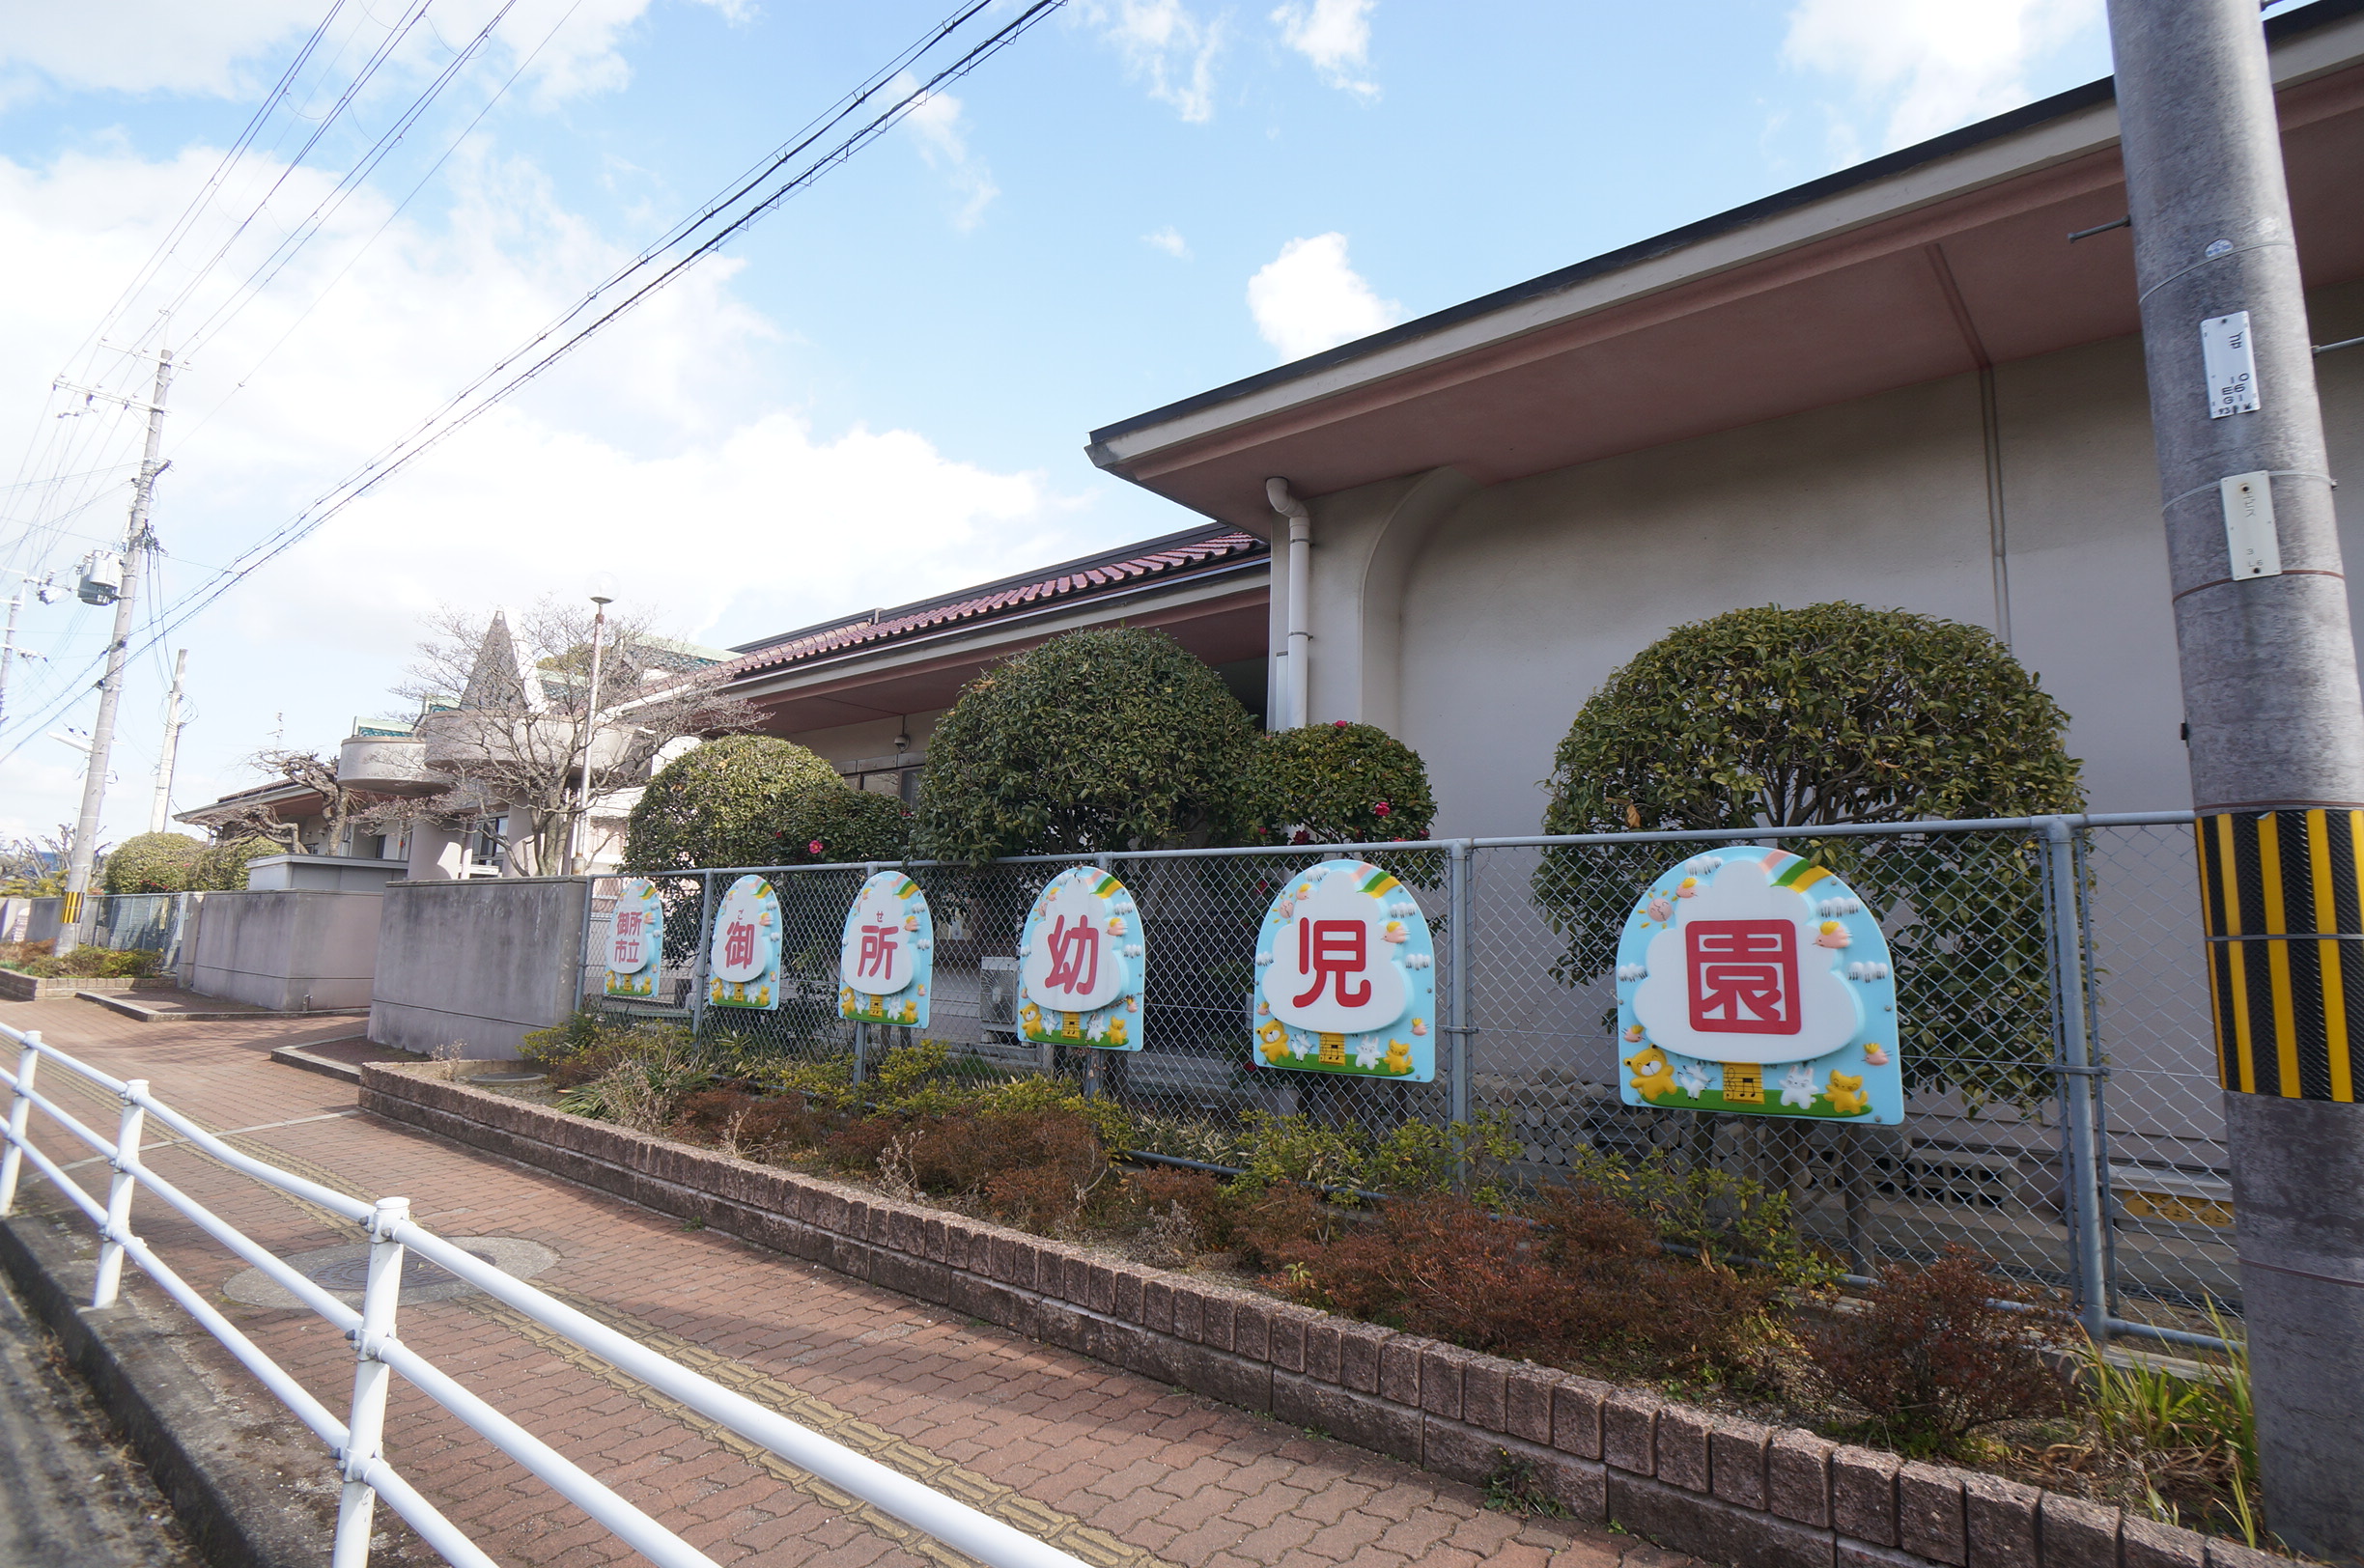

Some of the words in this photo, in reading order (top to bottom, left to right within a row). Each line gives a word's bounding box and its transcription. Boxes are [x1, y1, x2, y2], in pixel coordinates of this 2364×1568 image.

[616, 911, 643, 937] 御所
[876, 910, 884, 923] せ
[614, 938, 640, 964] 市立
[724, 921, 755, 969] 御
[858, 925, 899, 981] 所
[1045, 914, 1099, 994] 幼
[1292, 917, 1372, 1008] 児
[1685, 919, 1801, 1035] 園
